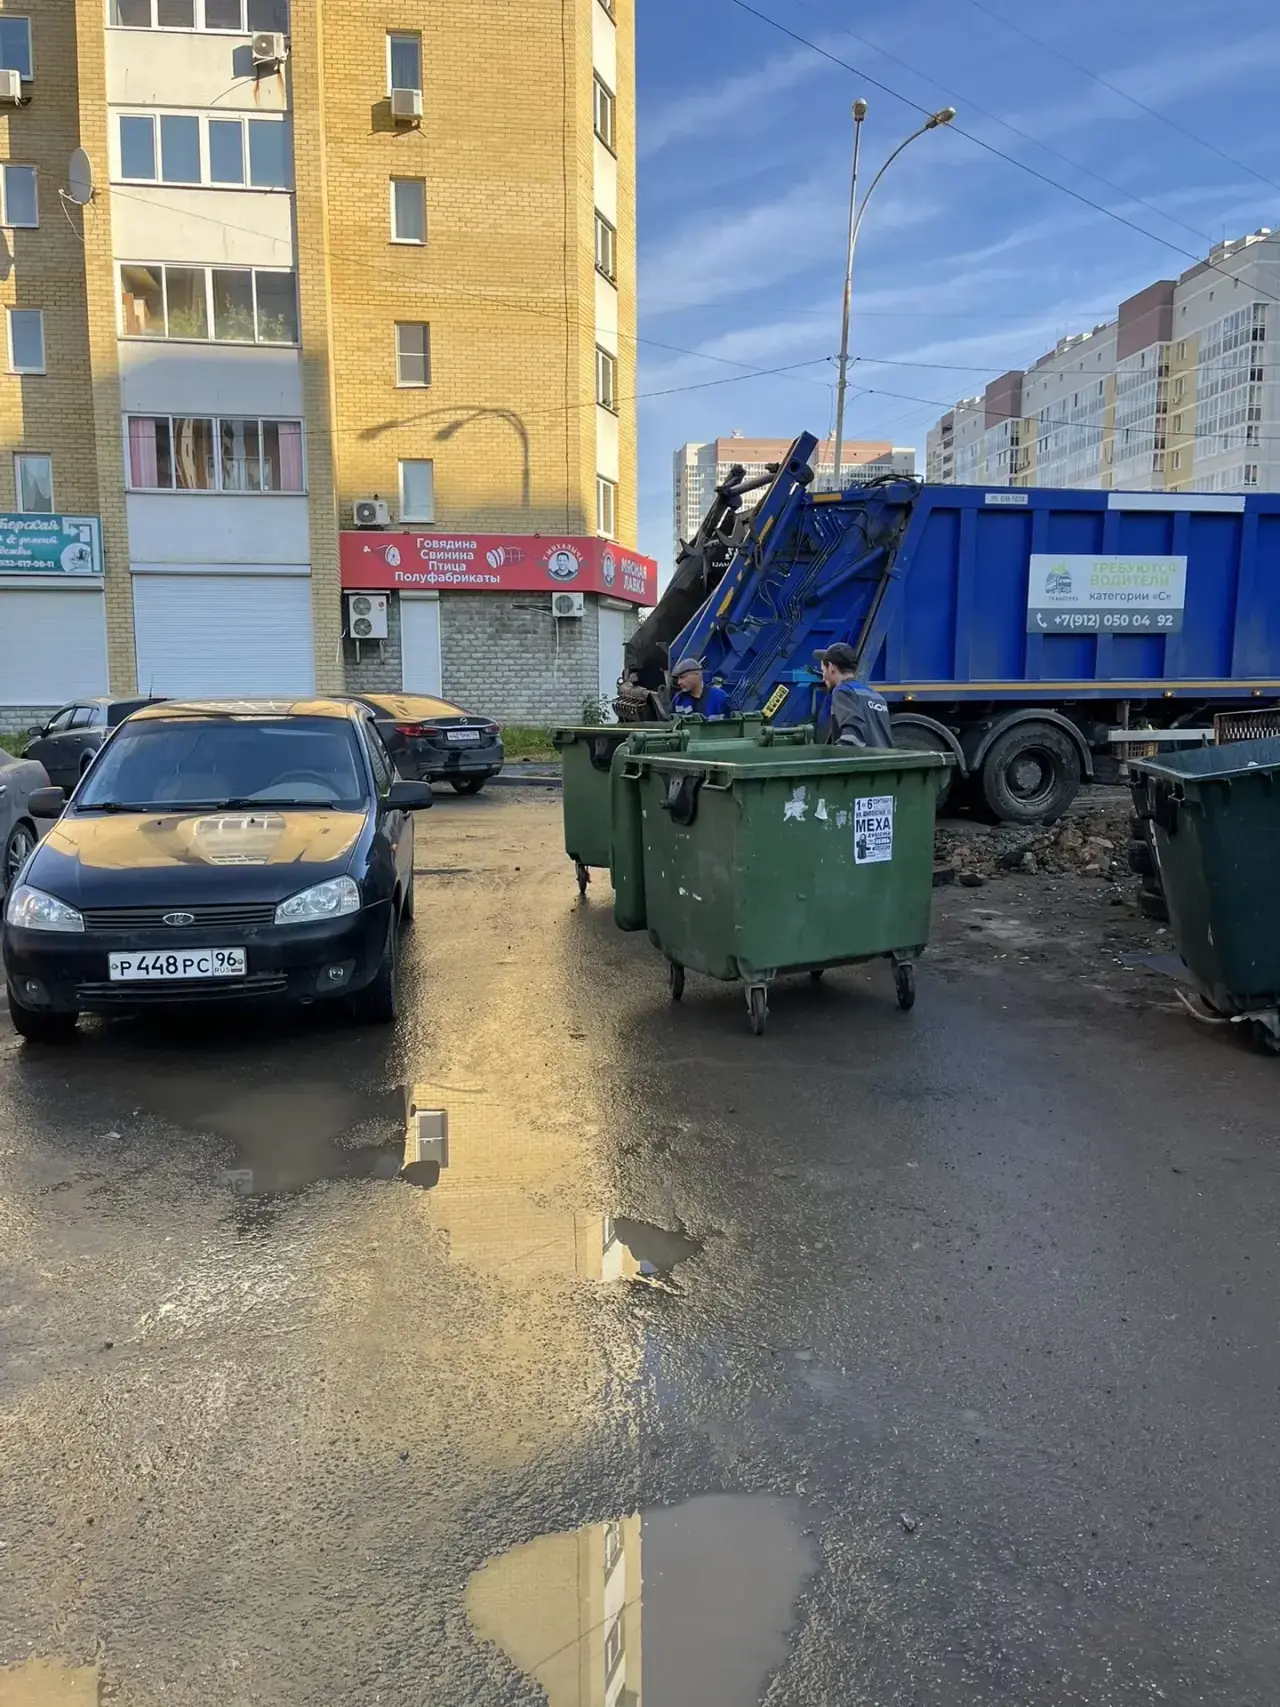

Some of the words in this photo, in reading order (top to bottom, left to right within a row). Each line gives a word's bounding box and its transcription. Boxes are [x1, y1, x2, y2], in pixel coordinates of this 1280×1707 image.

[19, 535, 59, 546] ремонт
[416, 538, 477, 550] Говядина
[420, 549, 475, 560] Свинина
[547, 543, 584, 562] МИХАЛЫЧА
[428, 560, 467, 572] Птица
[621, 557, 647, 580] МЯСНАЯ
[1092, 562, 1177, 574] ТРЕБУЮТСЯ
[394, 571, 501, 584] Полуфабрикаты
[1090, 574, 1170, 587] ВОДИТЕЛИ
[623, 575, 645, 595] ЛАВКА
[1089, 591, 1149, 603] категории
[1054, 614, 1100, 629] +7(912)
[1103, 614, 1129, 627] 050
[1132, 614, 1151, 627] 04
[1157, 614, 1173, 626] 92
[856, 800, 860, 810] 1
[867, 799, 873, 810] 6
[855, 817, 891, 833] МЕХА
[215, 952, 237, 967] 96
